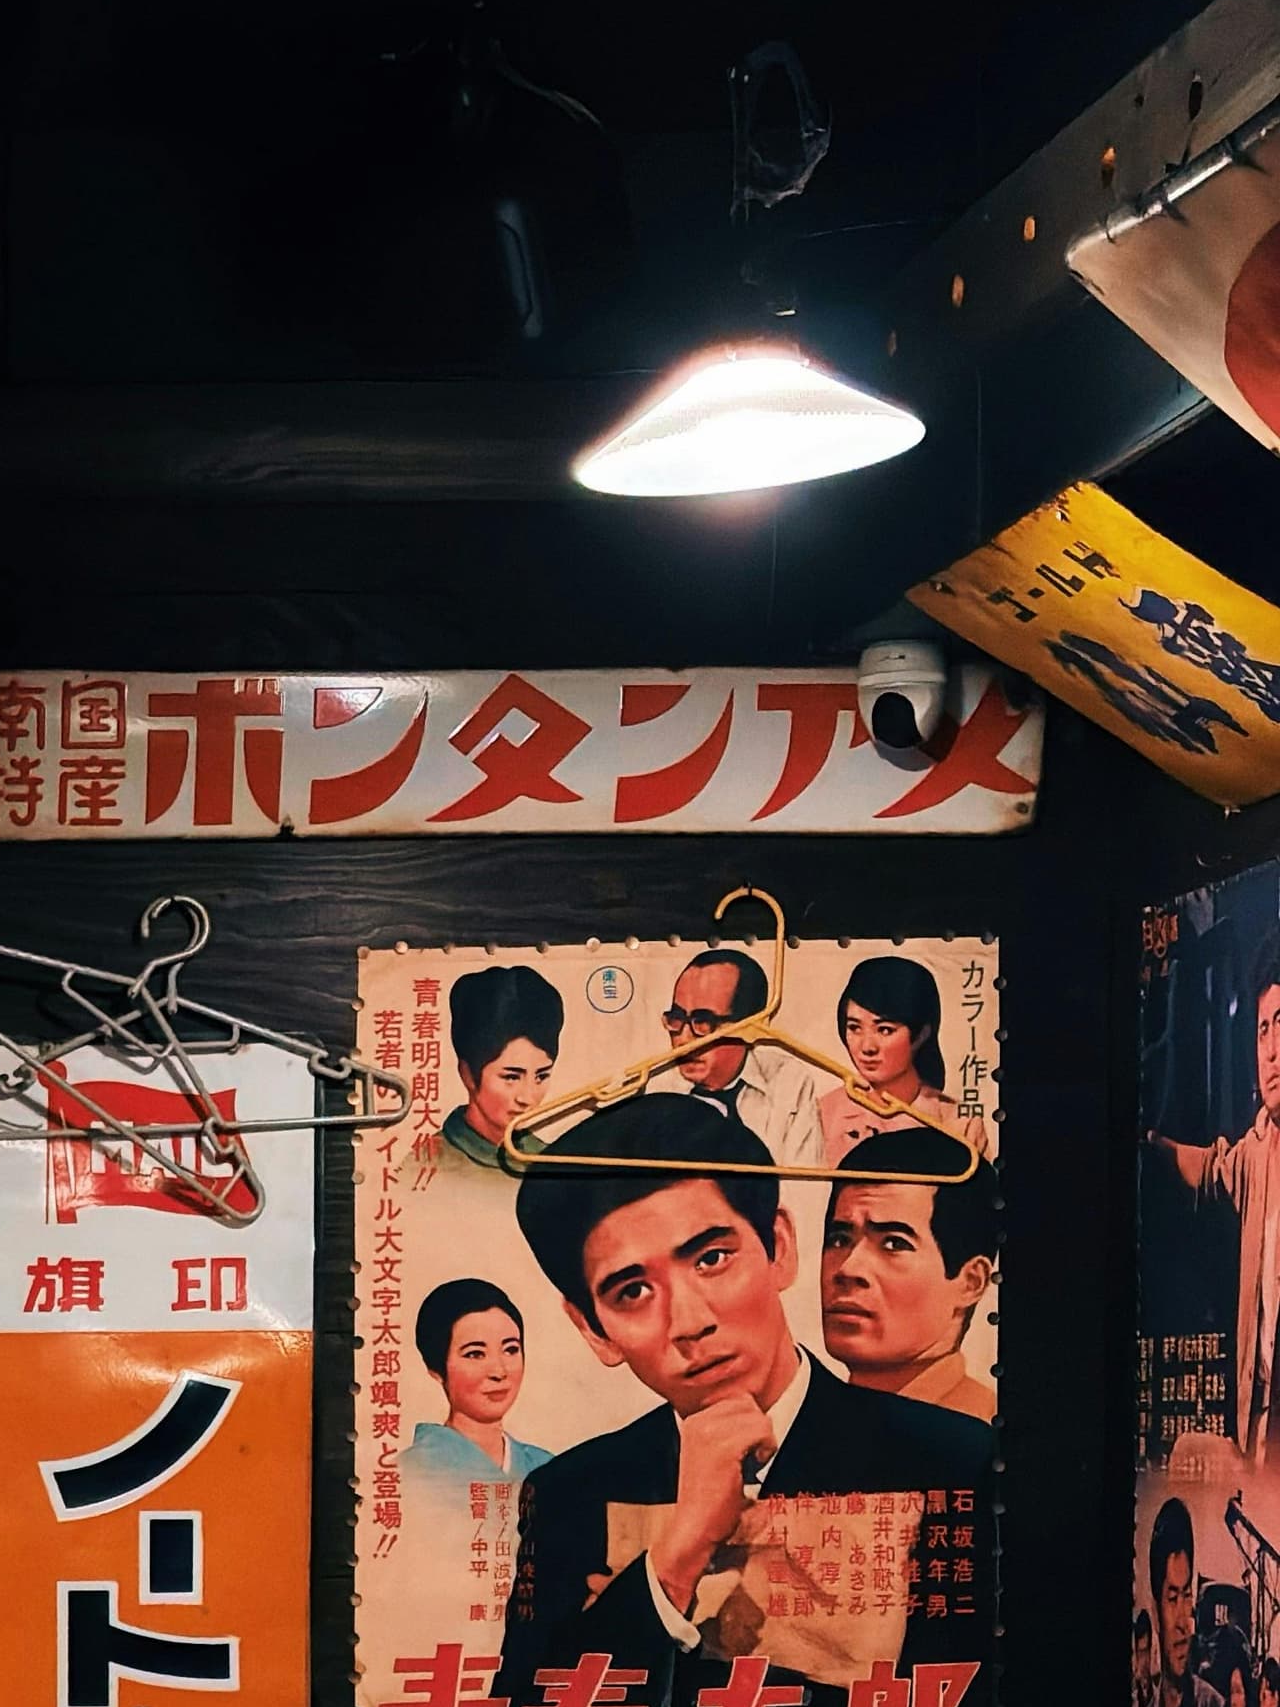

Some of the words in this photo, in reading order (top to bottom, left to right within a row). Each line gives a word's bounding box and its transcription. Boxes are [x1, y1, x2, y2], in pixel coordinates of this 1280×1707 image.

[145, 669, 1041, 829] ボンタンアメ
[957, 961, 988, 1118] カラー作品
[91, 1121, 235, 1178] MAIL
[370, 1010, 405, 1558] 若者のイドル大文字太郎颯爽と登場!!
[872, 1494, 896, 1617] 酒井和歌子
[900, 1491, 923, 1616] 沢井桂子
[927, 1489, 948, 1618] 黒沢年男
[953, 1489, 975, 1613] 石坂浩二
